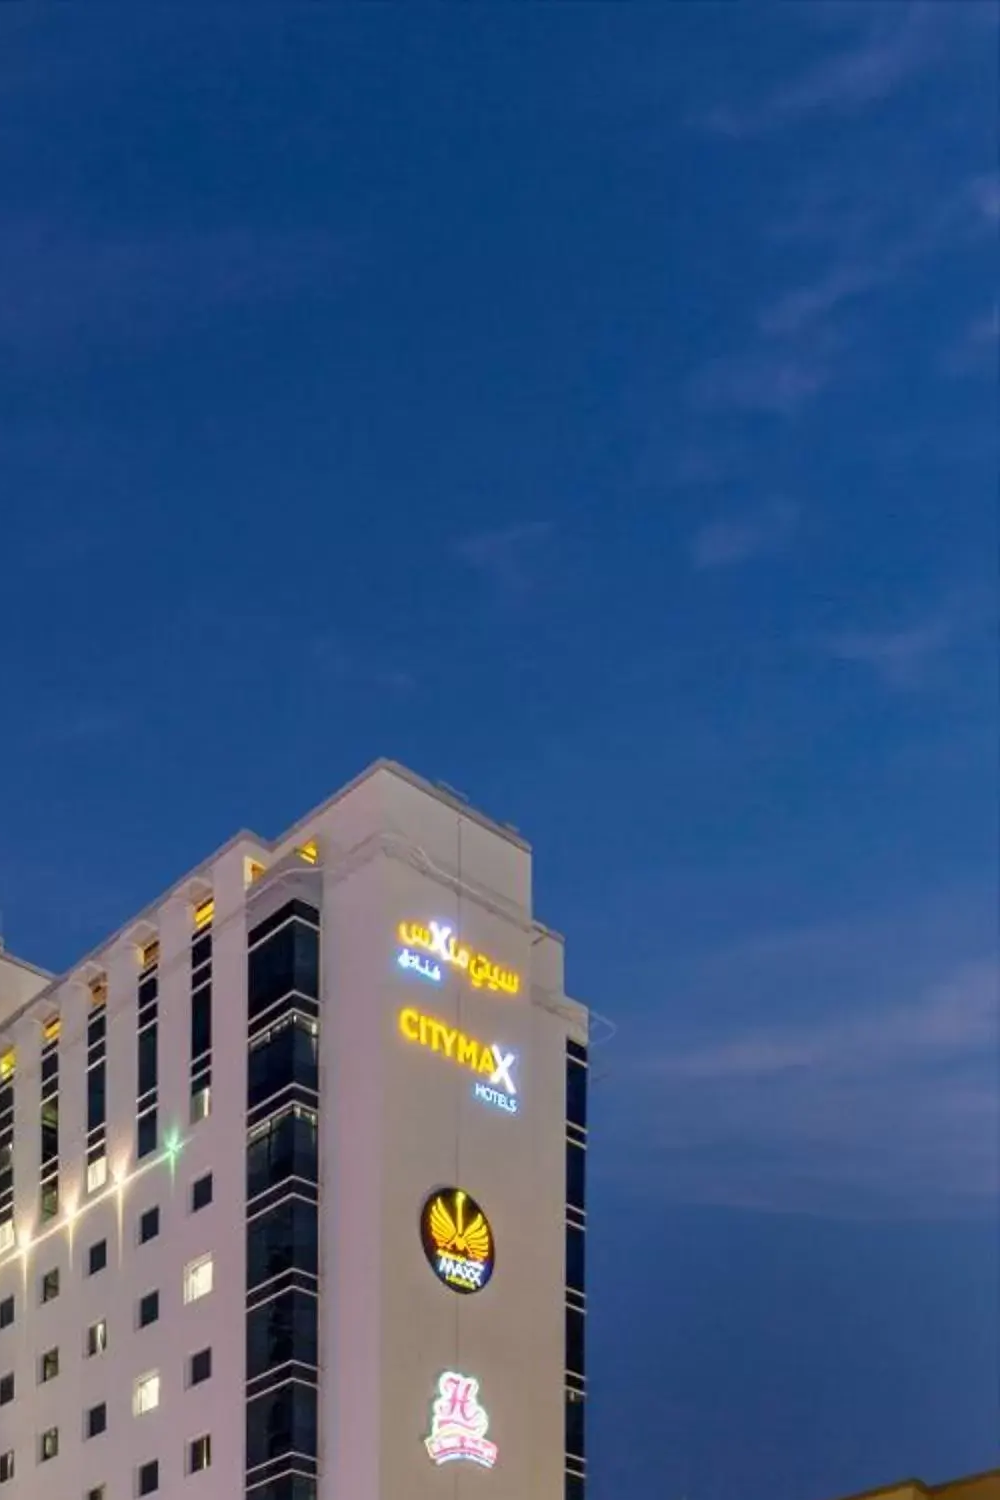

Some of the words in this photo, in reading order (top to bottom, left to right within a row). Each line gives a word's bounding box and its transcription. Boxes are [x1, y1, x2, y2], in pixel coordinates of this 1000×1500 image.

[470, 954, 520, 993] سيتي
[399, 1008, 516, 1094] CITYMAX
[474, 1083, 518, 1113] HOTELS
